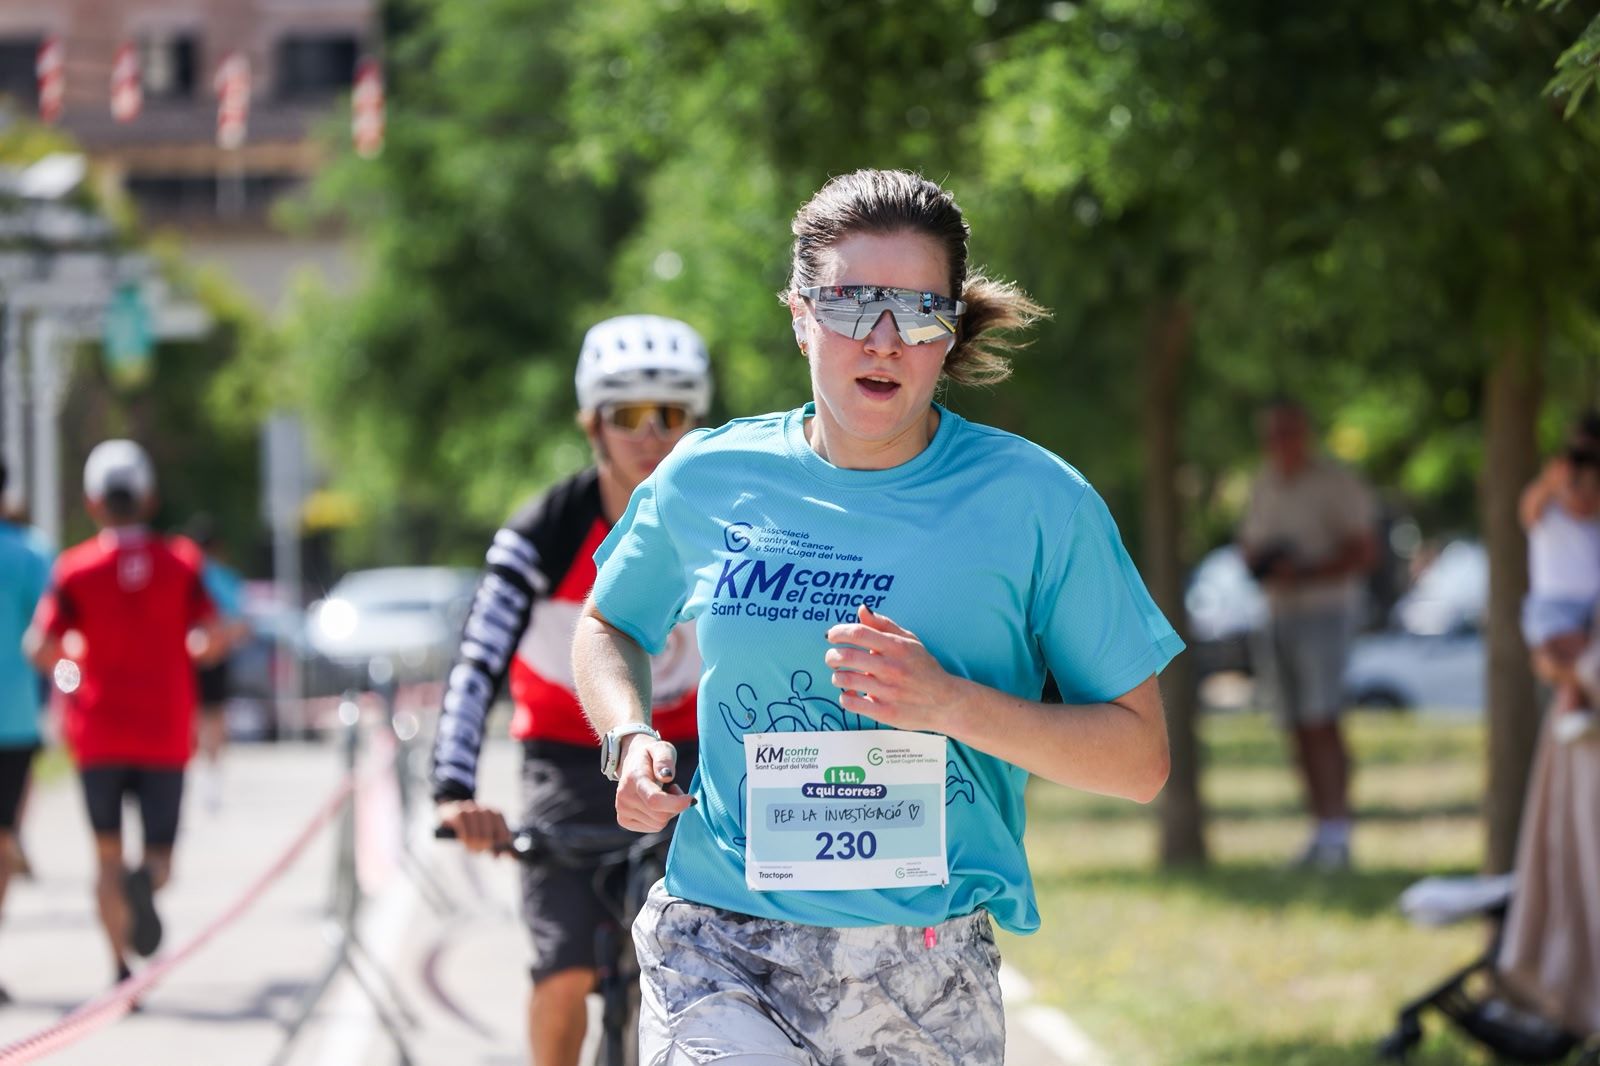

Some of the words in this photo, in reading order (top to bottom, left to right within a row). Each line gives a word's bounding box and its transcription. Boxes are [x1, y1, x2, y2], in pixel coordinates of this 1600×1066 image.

[758, 537, 788, 546] contra
[790, 539, 800, 547] el
[763, 545, 785, 555] Sant
[786, 548, 816, 559] Cugat
[817, 551, 833, 560] del
[713, 559, 795, 601] KM
[793, 568, 895, 592] contra
[786, 586, 806, 603] el
[711, 602, 742, 616] Sant
[745, 602, 799, 622] Cugat
[802, 606, 830, 622] del
[755, 746, 785, 763] KM
[784, 746, 819, 756] contra
[838, 769, 860, 784] tu,
[806, 787, 814, 796] x
[815, 785, 835, 798] qui
[837, 786, 882, 797] corres?
[774, 809, 795, 824] PER
[802, 809, 817, 822] LA
[815, 830, 877, 860] 230
[758, 871, 794, 880] Tractopon
